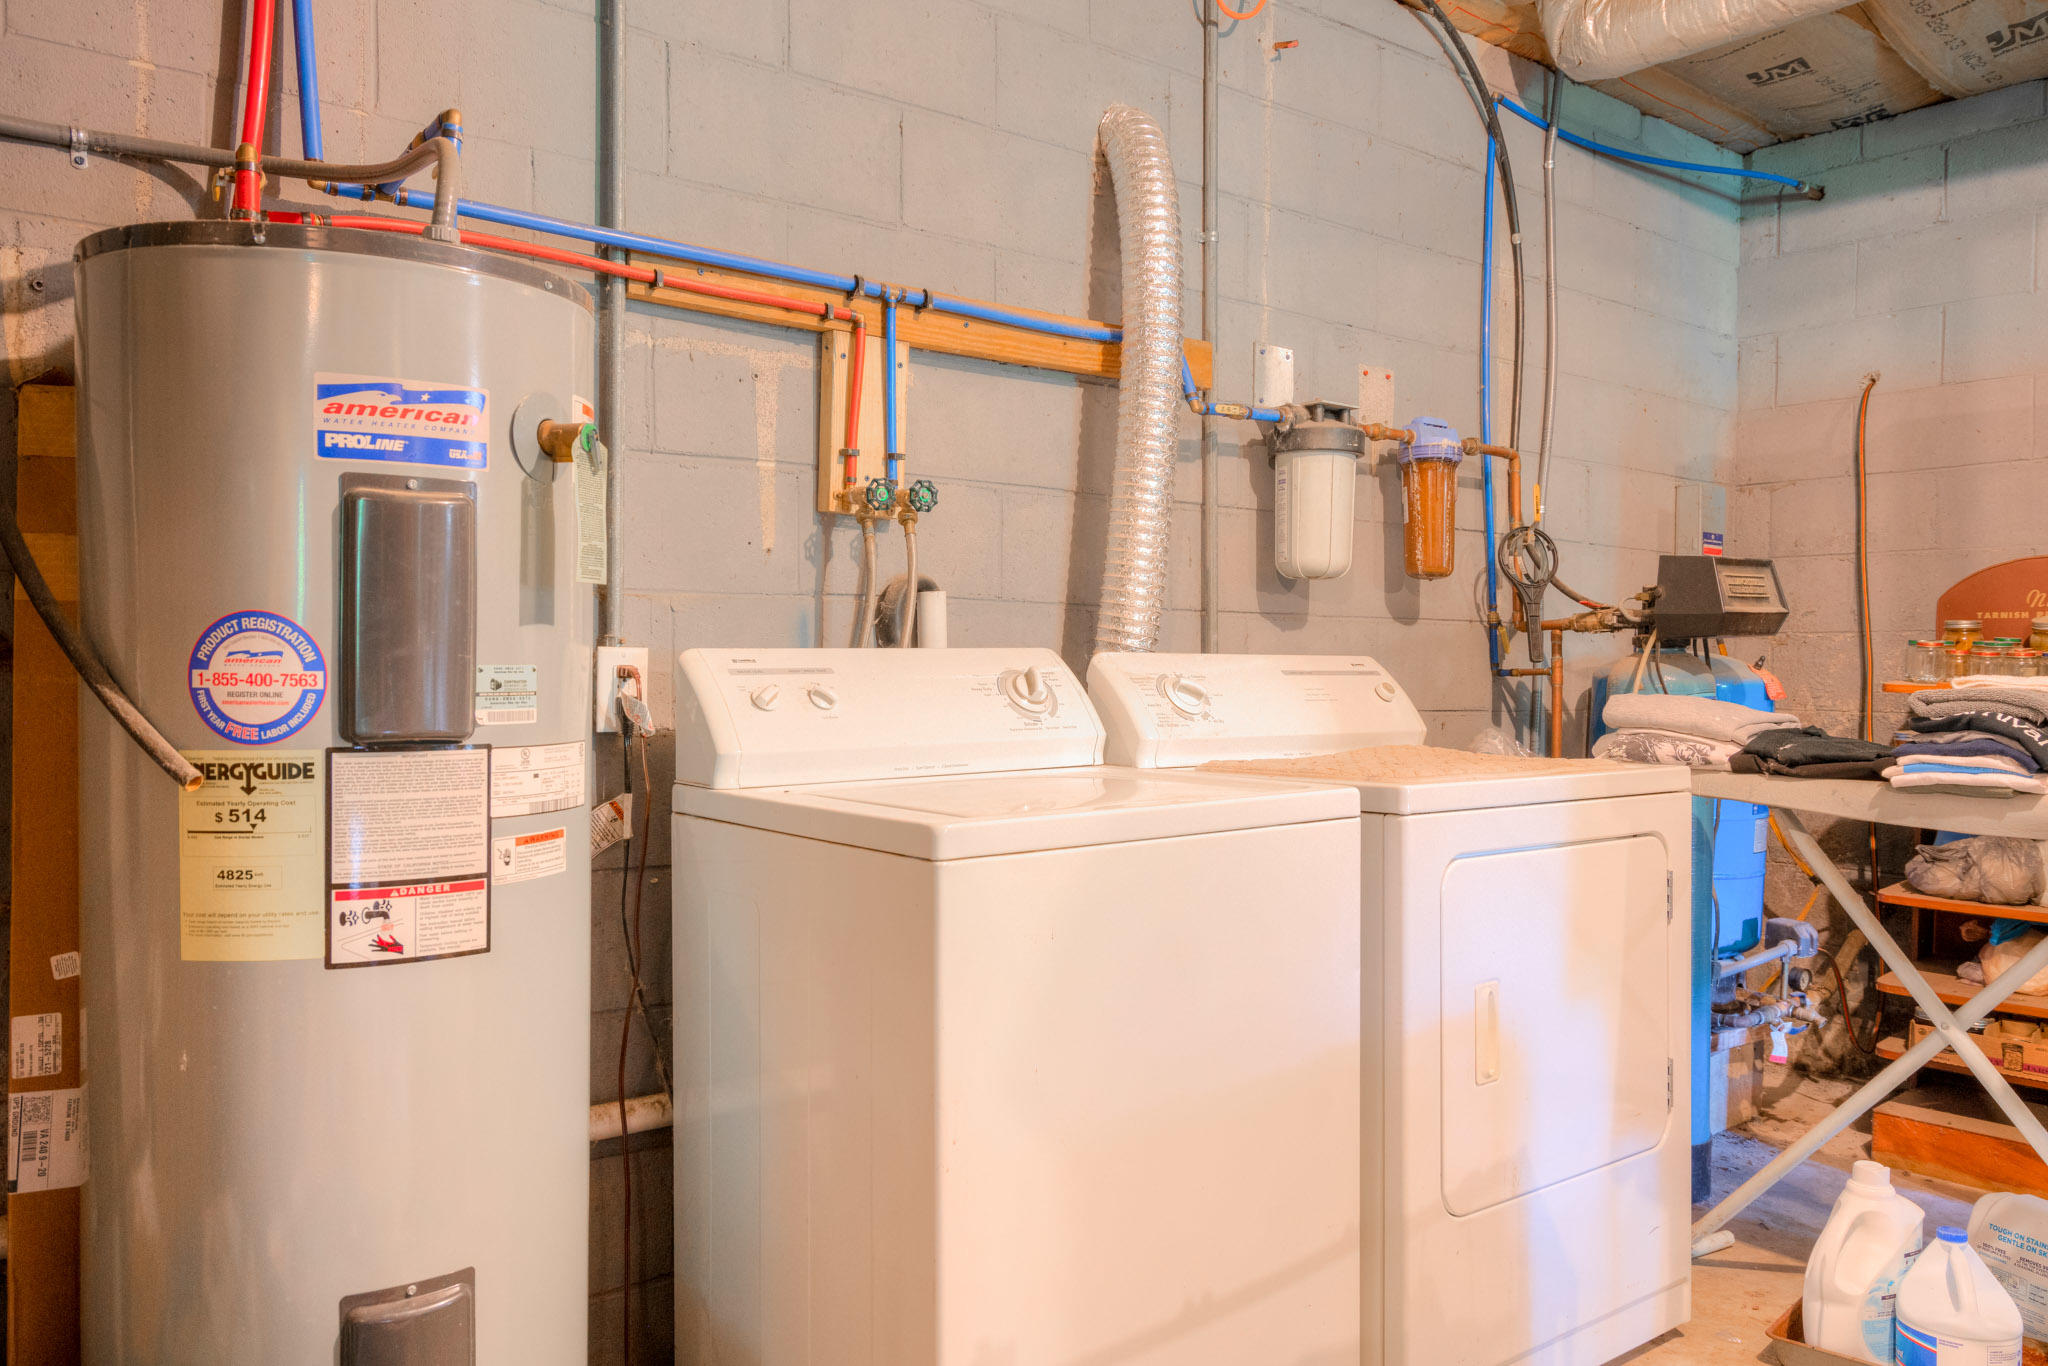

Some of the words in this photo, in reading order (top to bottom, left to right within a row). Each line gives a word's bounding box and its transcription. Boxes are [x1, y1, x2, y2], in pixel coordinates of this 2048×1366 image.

[323, 402, 479, 426] american
[323, 417, 363, 425] WATER
[371, 421, 416, 429] HEATER
[1977, 611, 2030, 619] TARNISH
[197, 620, 239, 661] PRODUCT
[241, 617, 318, 663] REGISTRATION
[197, 672, 318, 688] 1-855-400-7563
[196, 690, 210, 713] FIRST
[208, 708, 227, 730] YEAR
[225, 721, 259, 740] FREE
[261, 724, 290, 740] LABOR
[287, 692, 317, 728] INCLUDED
[190, 762, 315, 785] NERGYGUIDE
[227, 800, 246, 808] Yearly
[247, 800, 279, 808] Operating
[214, 811, 223, 823] $
[228, 808, 267, 823] 514
[216, 869, 254, 881] 4825
[400, 884, 450, 896] DANGER
[11, 1111, 19, 1137] GROUND
[39, 1128, 49, 1140] VA
[39, 1141, 48, 1154] 240
[1989, 1223, 2013, 1237] TOUGH
[2014, 1233, 2025, 1241] ON
[1997, 1234, 2025, 1249] GENTLE
[2026, 1244, 2037, 1254] ON
